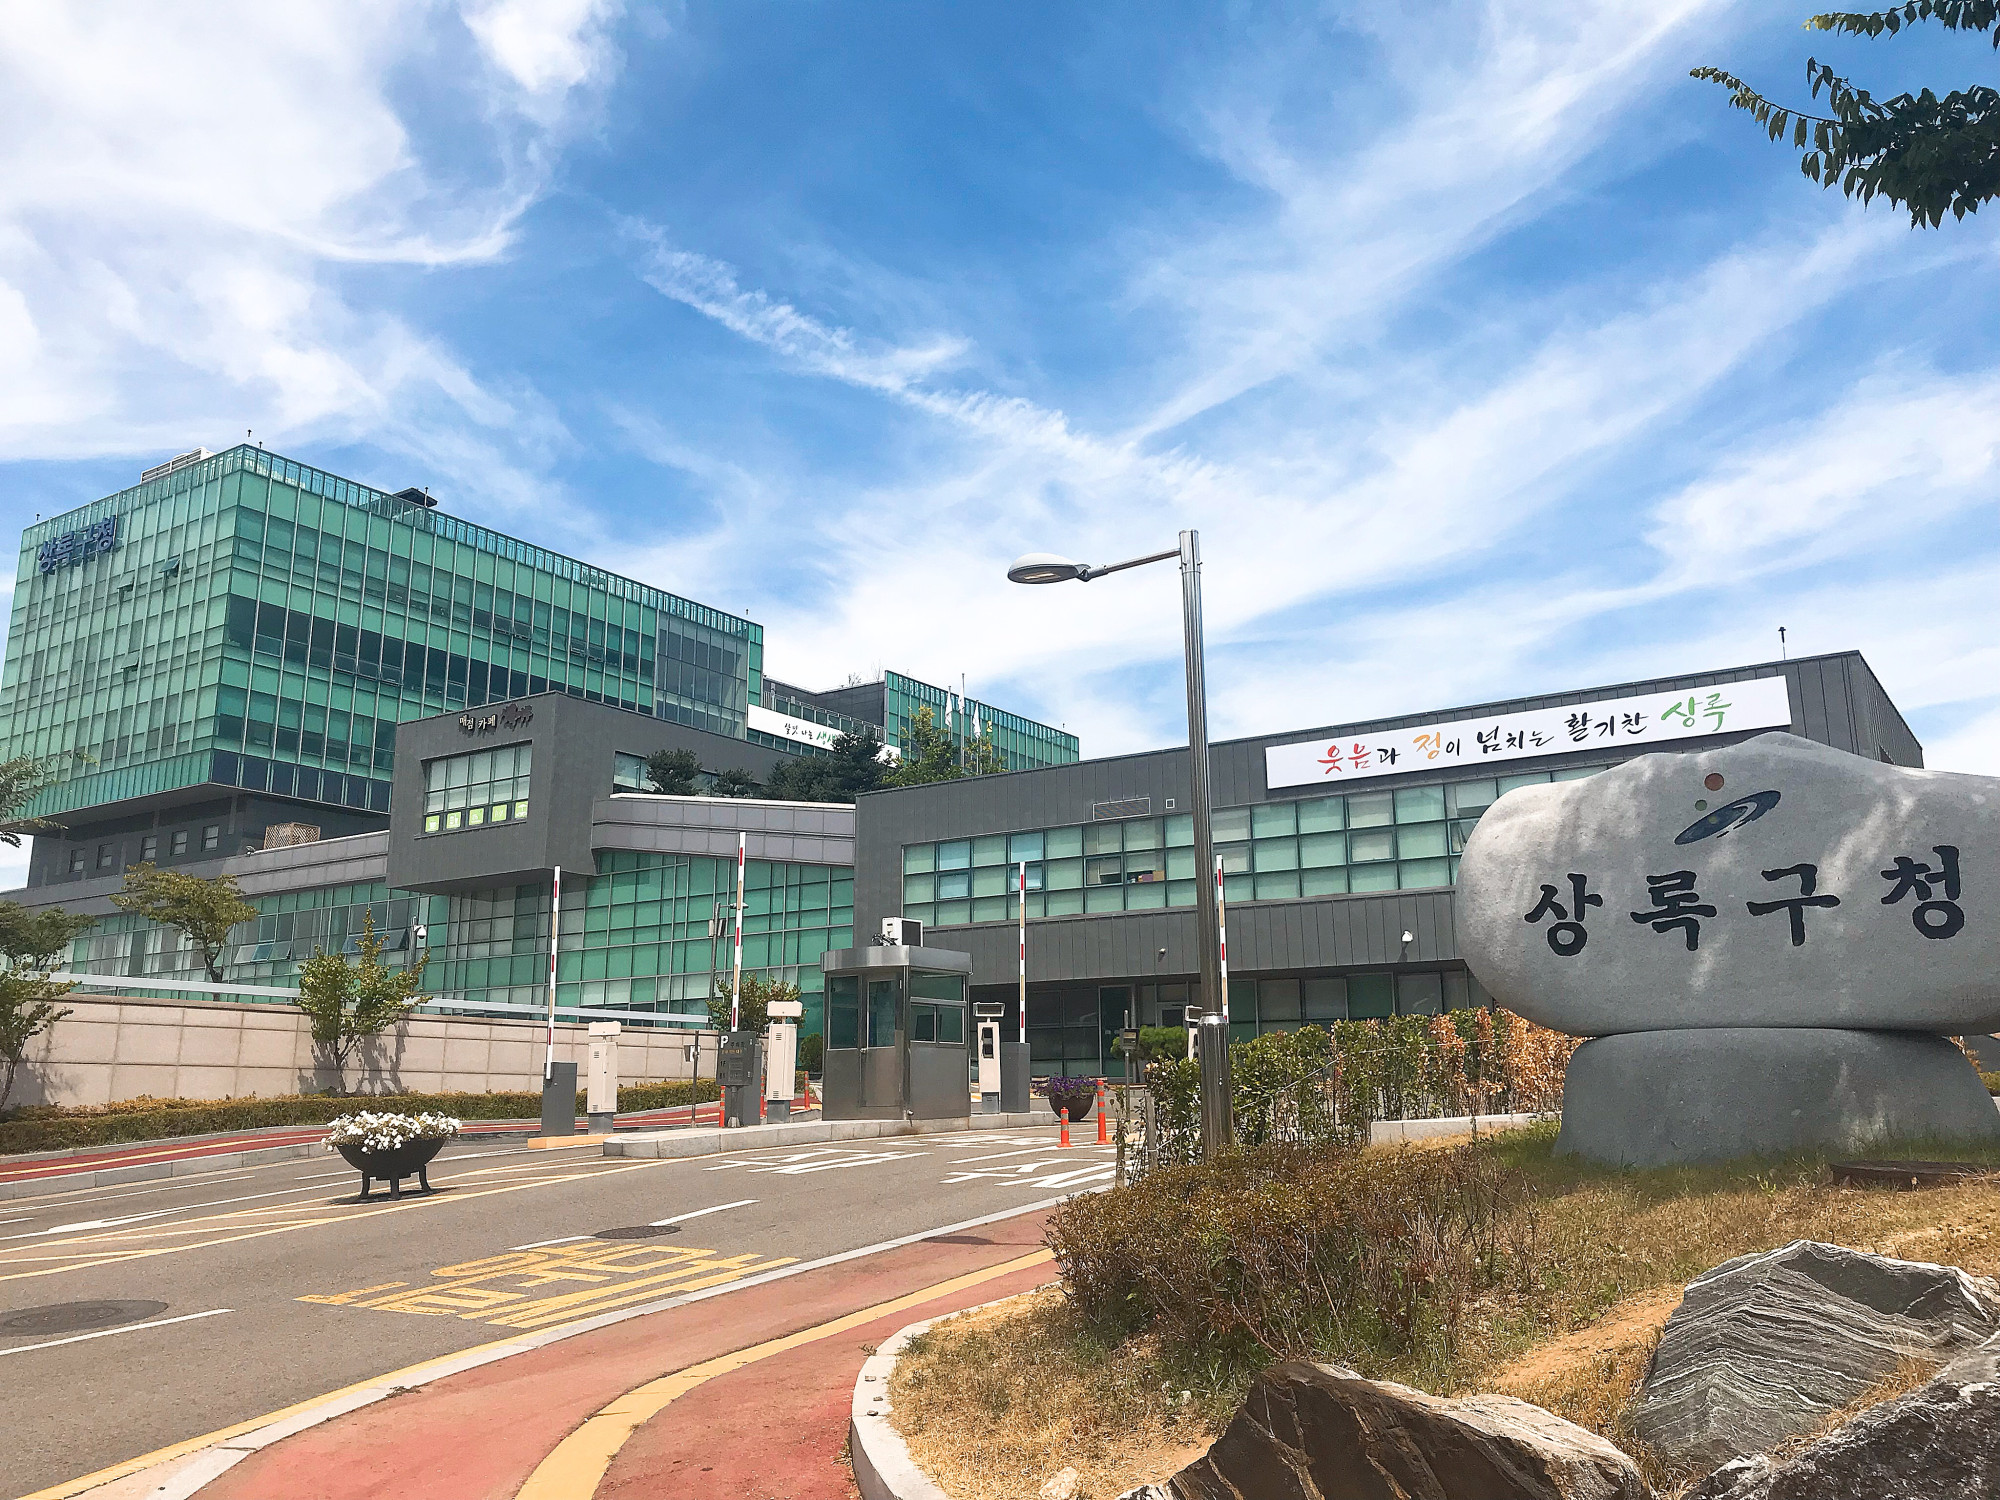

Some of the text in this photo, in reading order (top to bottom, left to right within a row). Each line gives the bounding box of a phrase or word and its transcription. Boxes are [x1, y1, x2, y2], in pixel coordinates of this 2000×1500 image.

[38, 515, 116, 572] 상록구청
[459, 714, 496, 730] 매점 카페
[801, 730, 814, 740] 나는
[1317, 693, 1732, 775] 웃음과 정이 넘치는 활기찬 상록
[1524, 845, 1965, 957] 상록구청
[720, 1035, 729, 1048] P
[702, 1148, 935, 1175] 주차
[293, 1241, 801, 1328] 화물차
